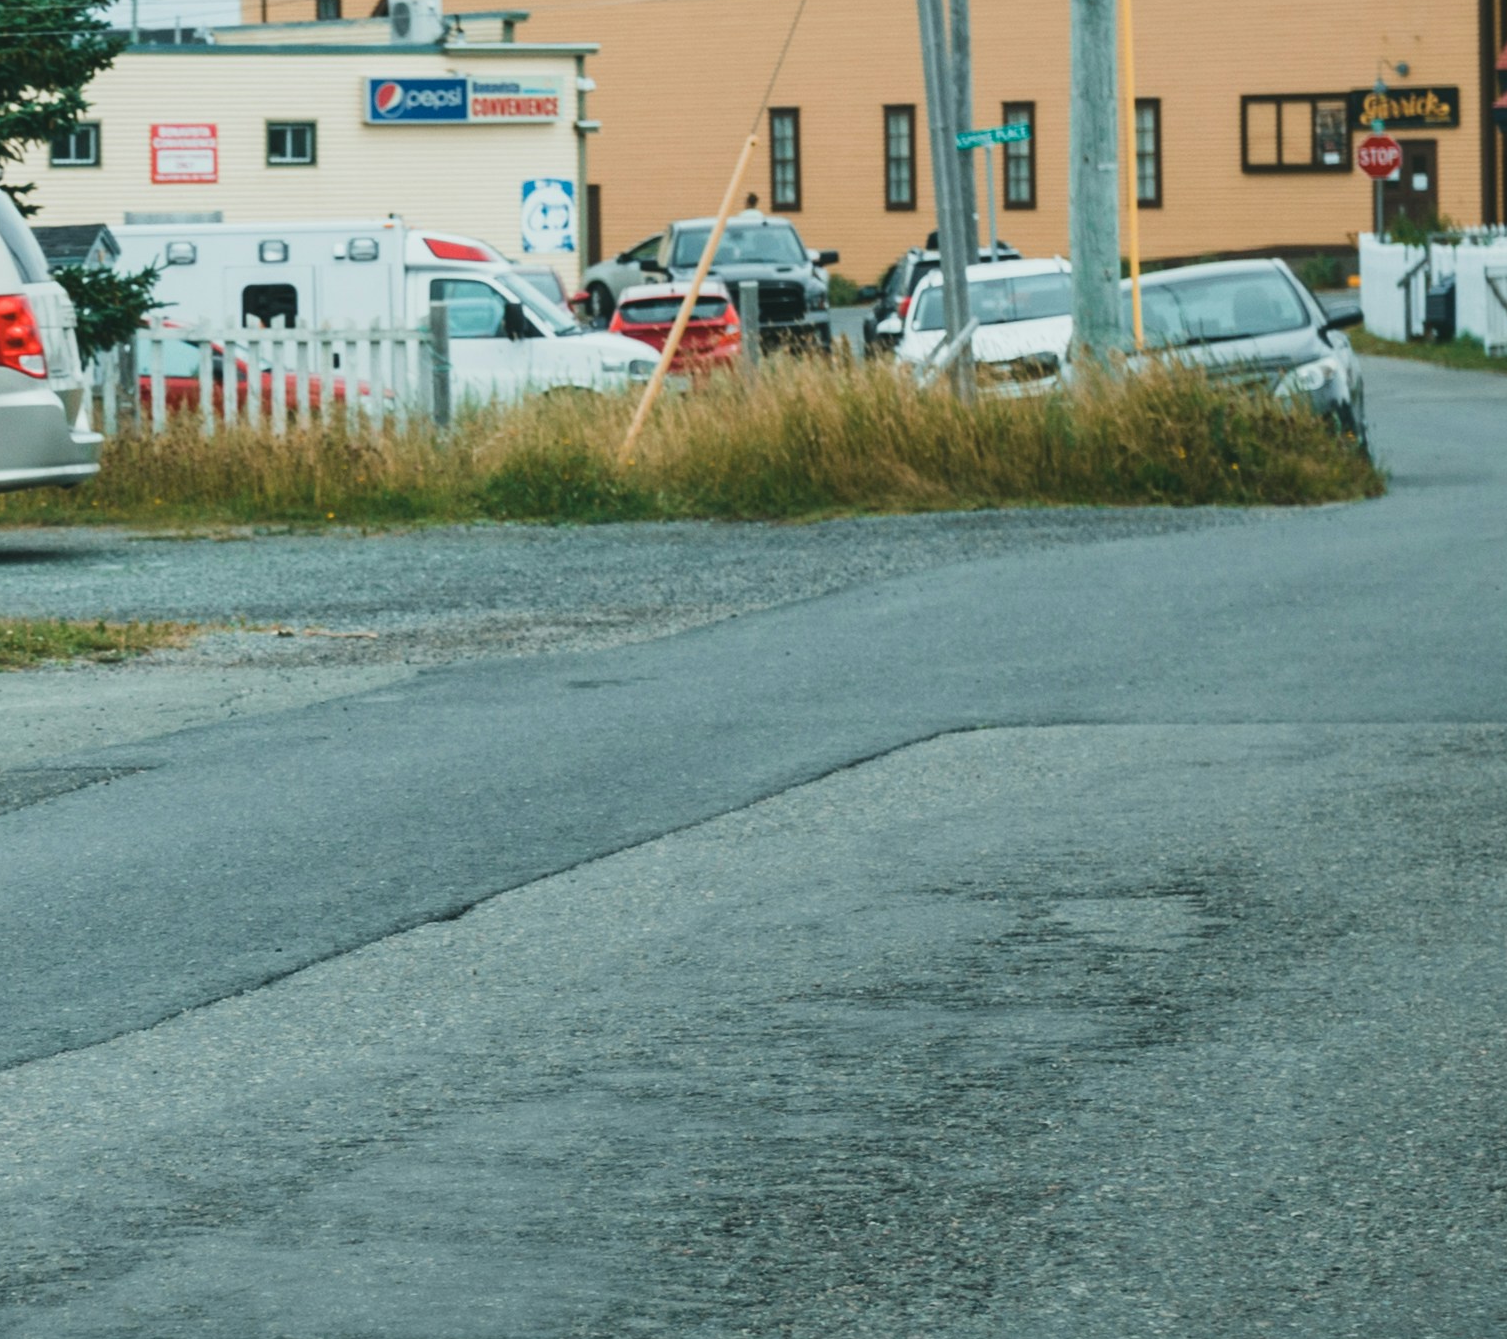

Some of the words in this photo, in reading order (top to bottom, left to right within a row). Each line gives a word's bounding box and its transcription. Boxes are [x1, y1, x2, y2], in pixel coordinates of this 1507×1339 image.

[405, 87, 462, 109] pepsi
[472, 97, 559, 117] CONVENIENCE
[1359, 147, 1399, 166] STOP
